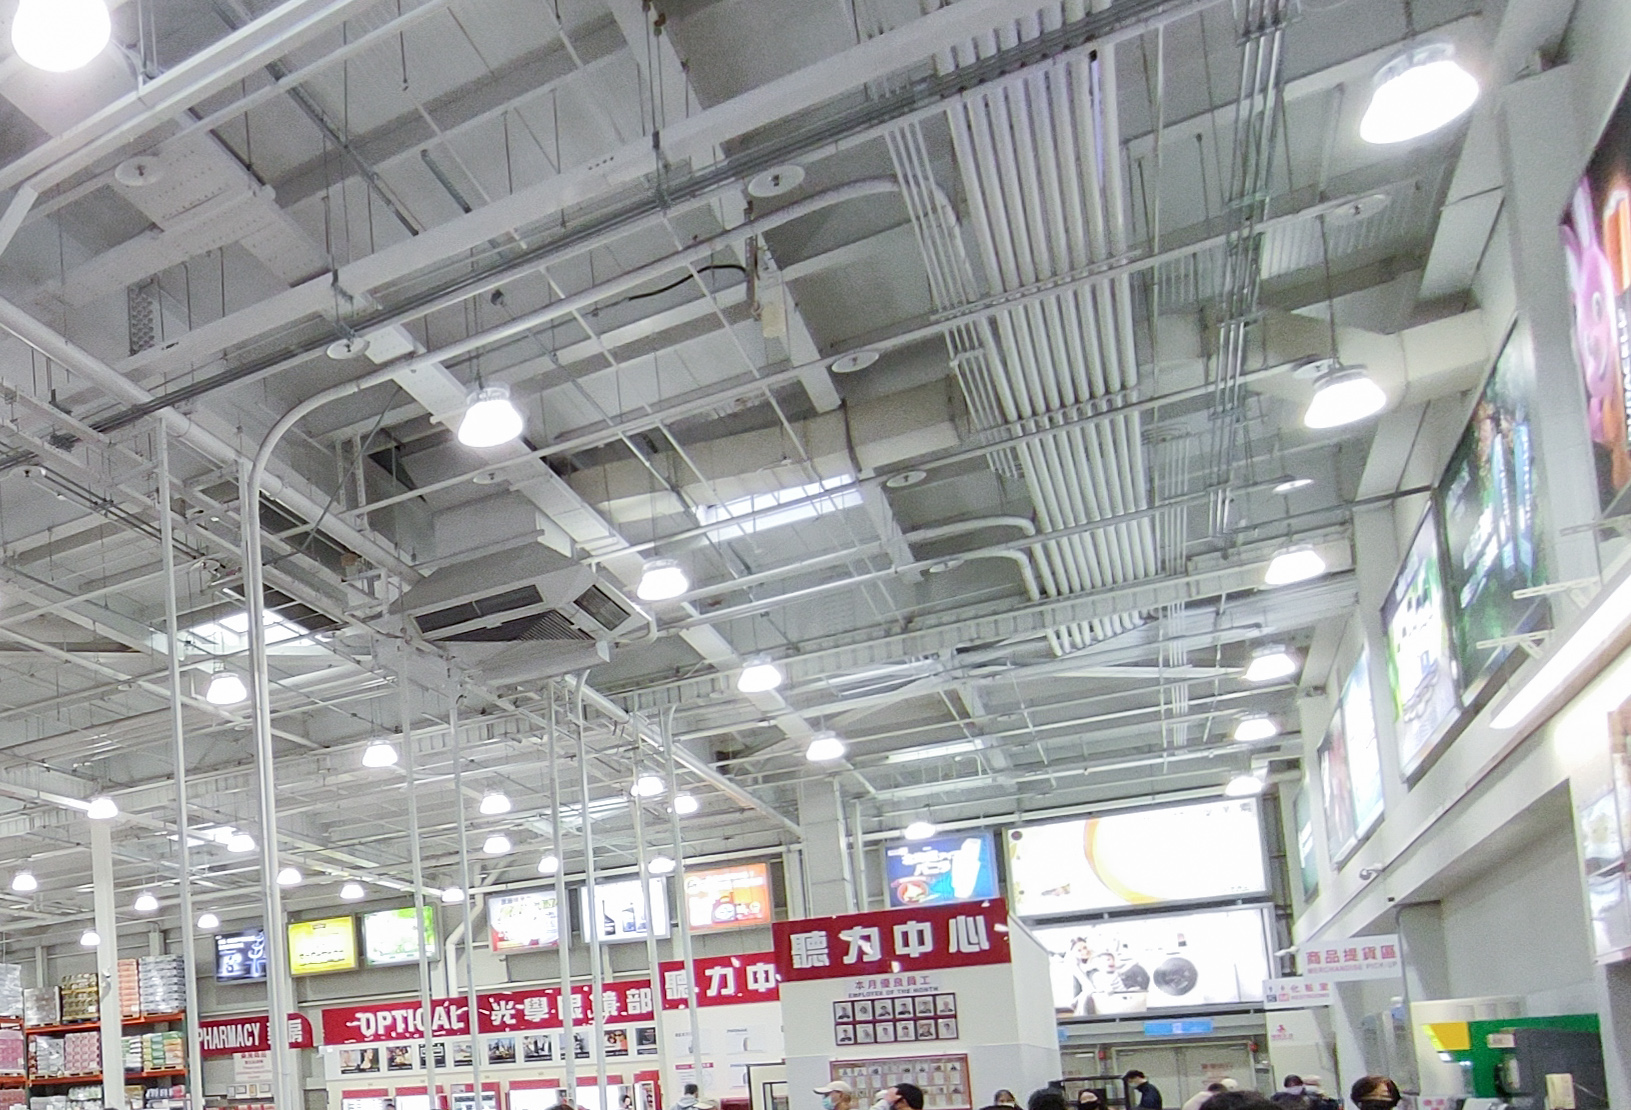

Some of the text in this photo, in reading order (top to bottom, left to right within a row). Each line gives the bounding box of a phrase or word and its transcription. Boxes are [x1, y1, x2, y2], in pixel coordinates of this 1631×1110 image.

[790, 915, 990, 969] 聽力中心
[1306, 944, 1396, 965] 商品提貨區
[855, 975, 931, 990] 本月優良員工
[198, 1022, 261, 1051] PHARMACY
[360, 1009, 464, 1037] OPTICAL
